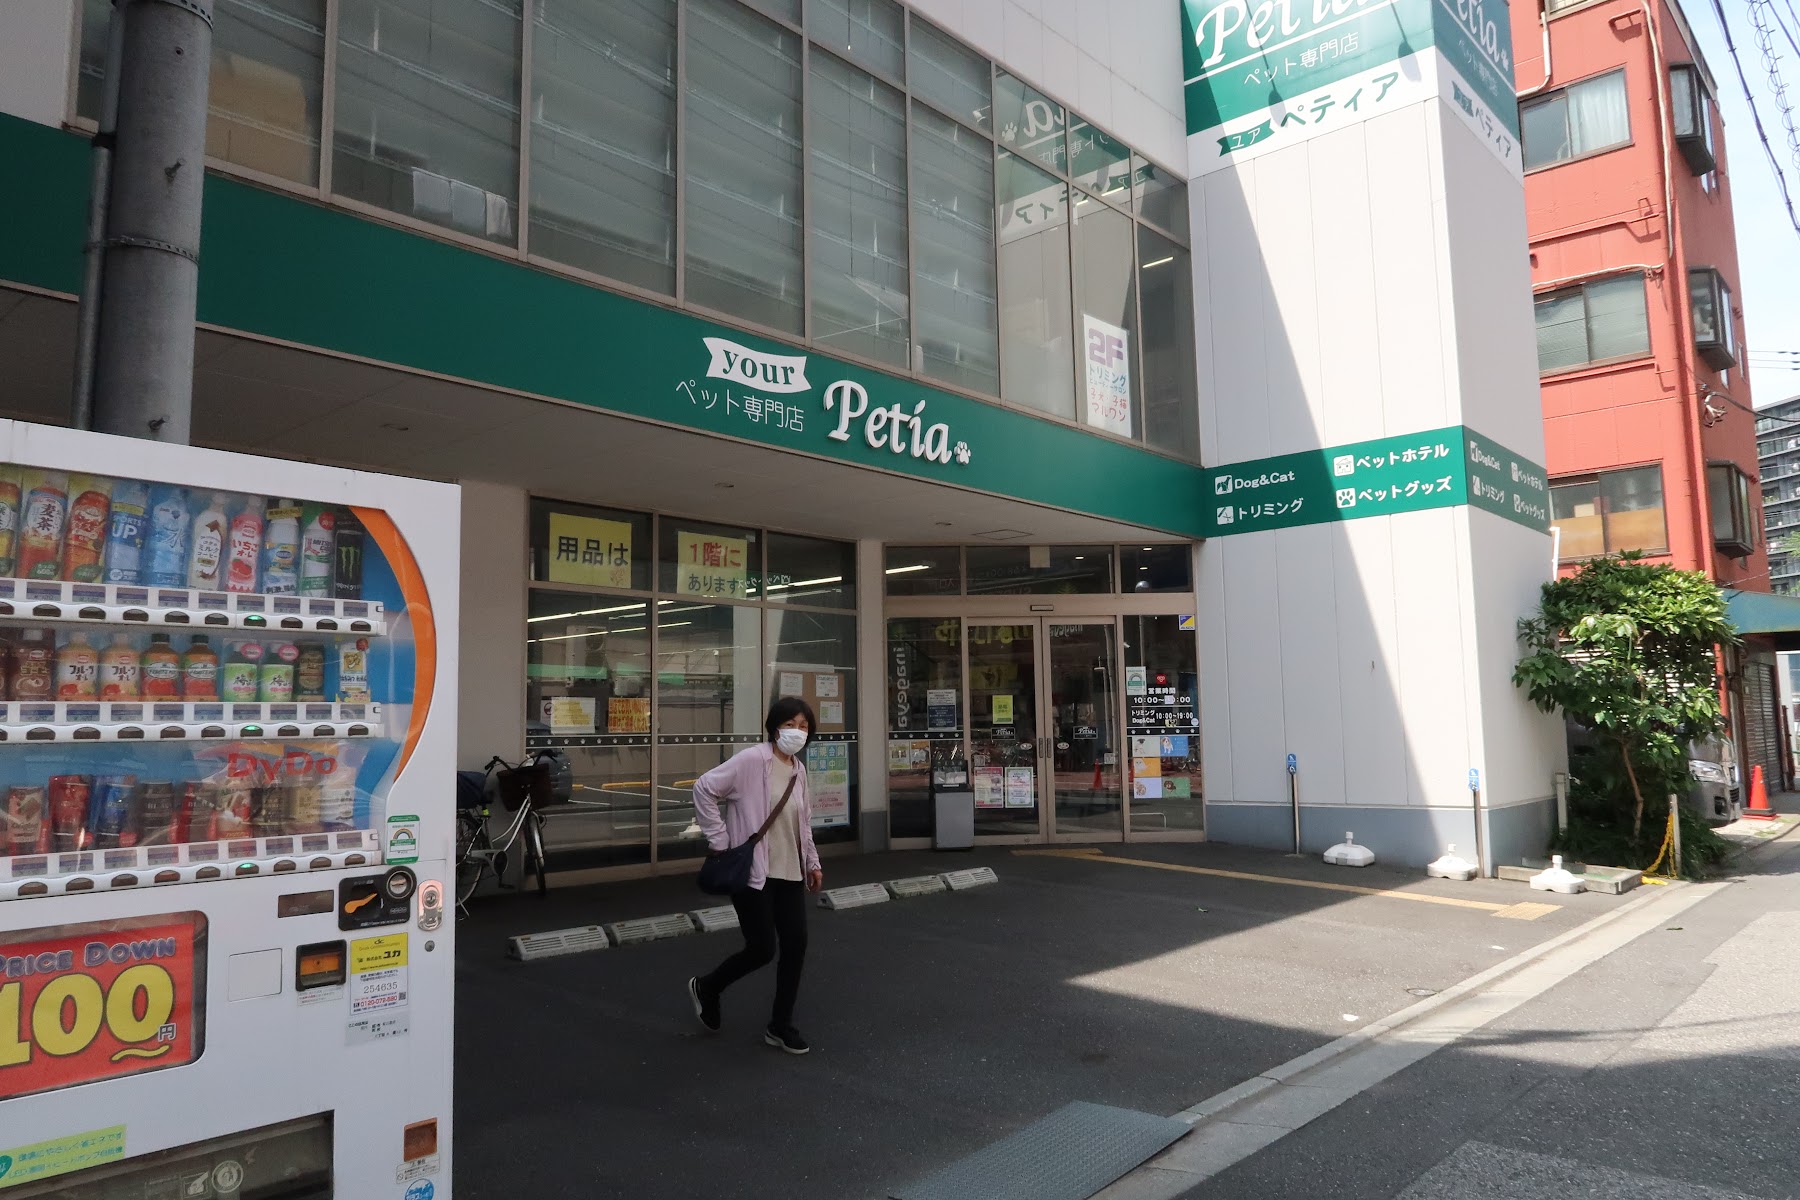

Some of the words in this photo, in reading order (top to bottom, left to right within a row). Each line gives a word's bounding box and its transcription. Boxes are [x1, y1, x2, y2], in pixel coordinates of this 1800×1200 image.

[1243, 31, 1359, 86] ペット専門店
[1280, 71, 1399, 128] ペティア
[1089, 328, 1123, 368] 2F
[722, 349, 795, 385] your
[1089, 364, 1126, 387] トリミング
[676, 379, 804, 431] ペット専門店
[1092, 402, 1126, 422] マルワン
[1356, 443, 1450, 469] ペットホテル
[1234, 470, 1295, 489] Dog&Cat
[1358, 475, 1453, 502] ペットグッズ
[37, 503, 56, 531] 麦茶
[1238, 497, 1304, 520] トリミング
[556, 535, 629, 566] 用品は
[688, 542, 742, 569] 1階に
[688, 573, 740, 594] あります
[1131, 709, 1155, 717] トリミング
[228, 751, 338, 785] DyDo
[363, 981, 398, 994] 254635
[0, 963, 175, 1068] 100
[157, 1022, 176, 1042] 円
